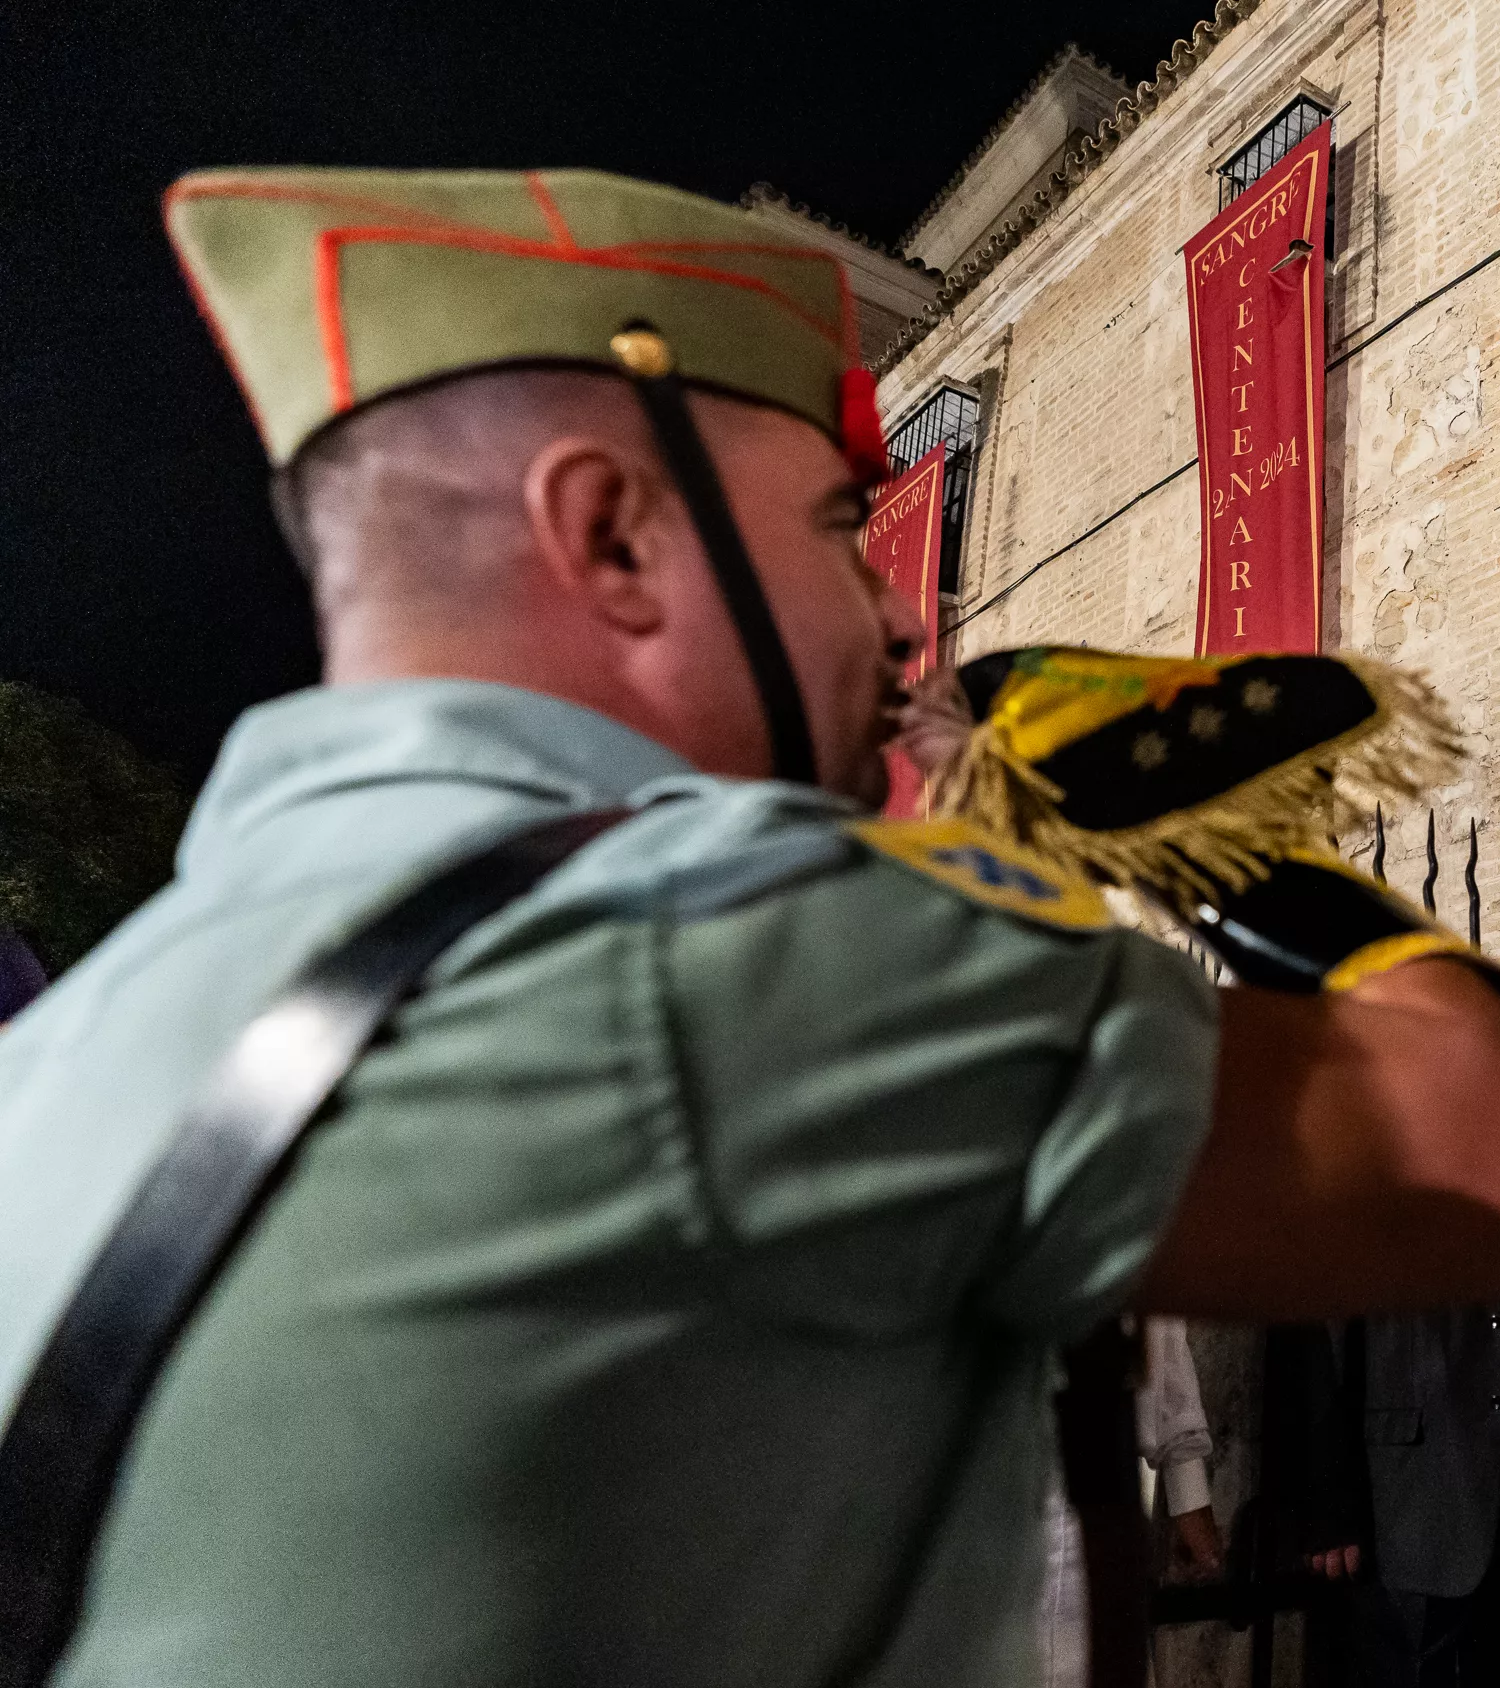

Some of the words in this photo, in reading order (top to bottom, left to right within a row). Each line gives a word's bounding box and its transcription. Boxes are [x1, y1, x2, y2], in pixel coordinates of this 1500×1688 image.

[1201, 171, 1302, 286] SANGRE
[1229, 258, 1256, 658] CENTENARI
[1260, 436, 1300, 490] 2024
[870, 476, 930, 542] SANGRE
